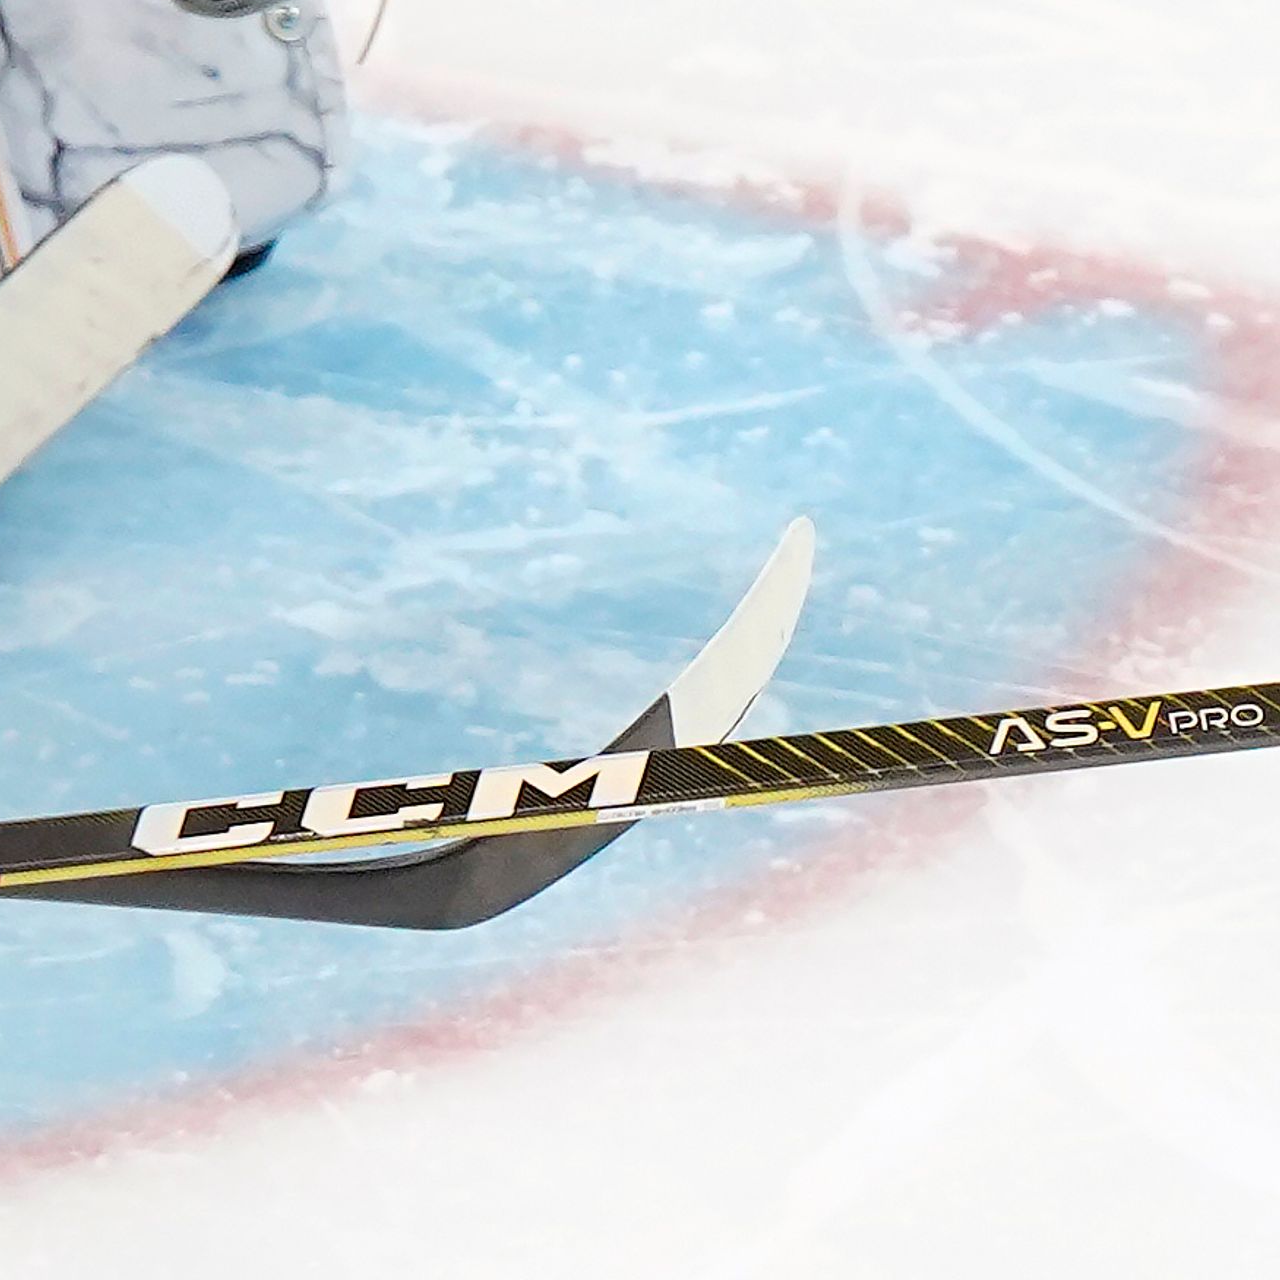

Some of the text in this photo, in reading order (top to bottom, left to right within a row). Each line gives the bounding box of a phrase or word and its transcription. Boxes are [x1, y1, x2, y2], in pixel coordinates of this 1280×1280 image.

[989, 701, 1264, 756] AS-V PRO
[131, 750, 651, 856] CCM
